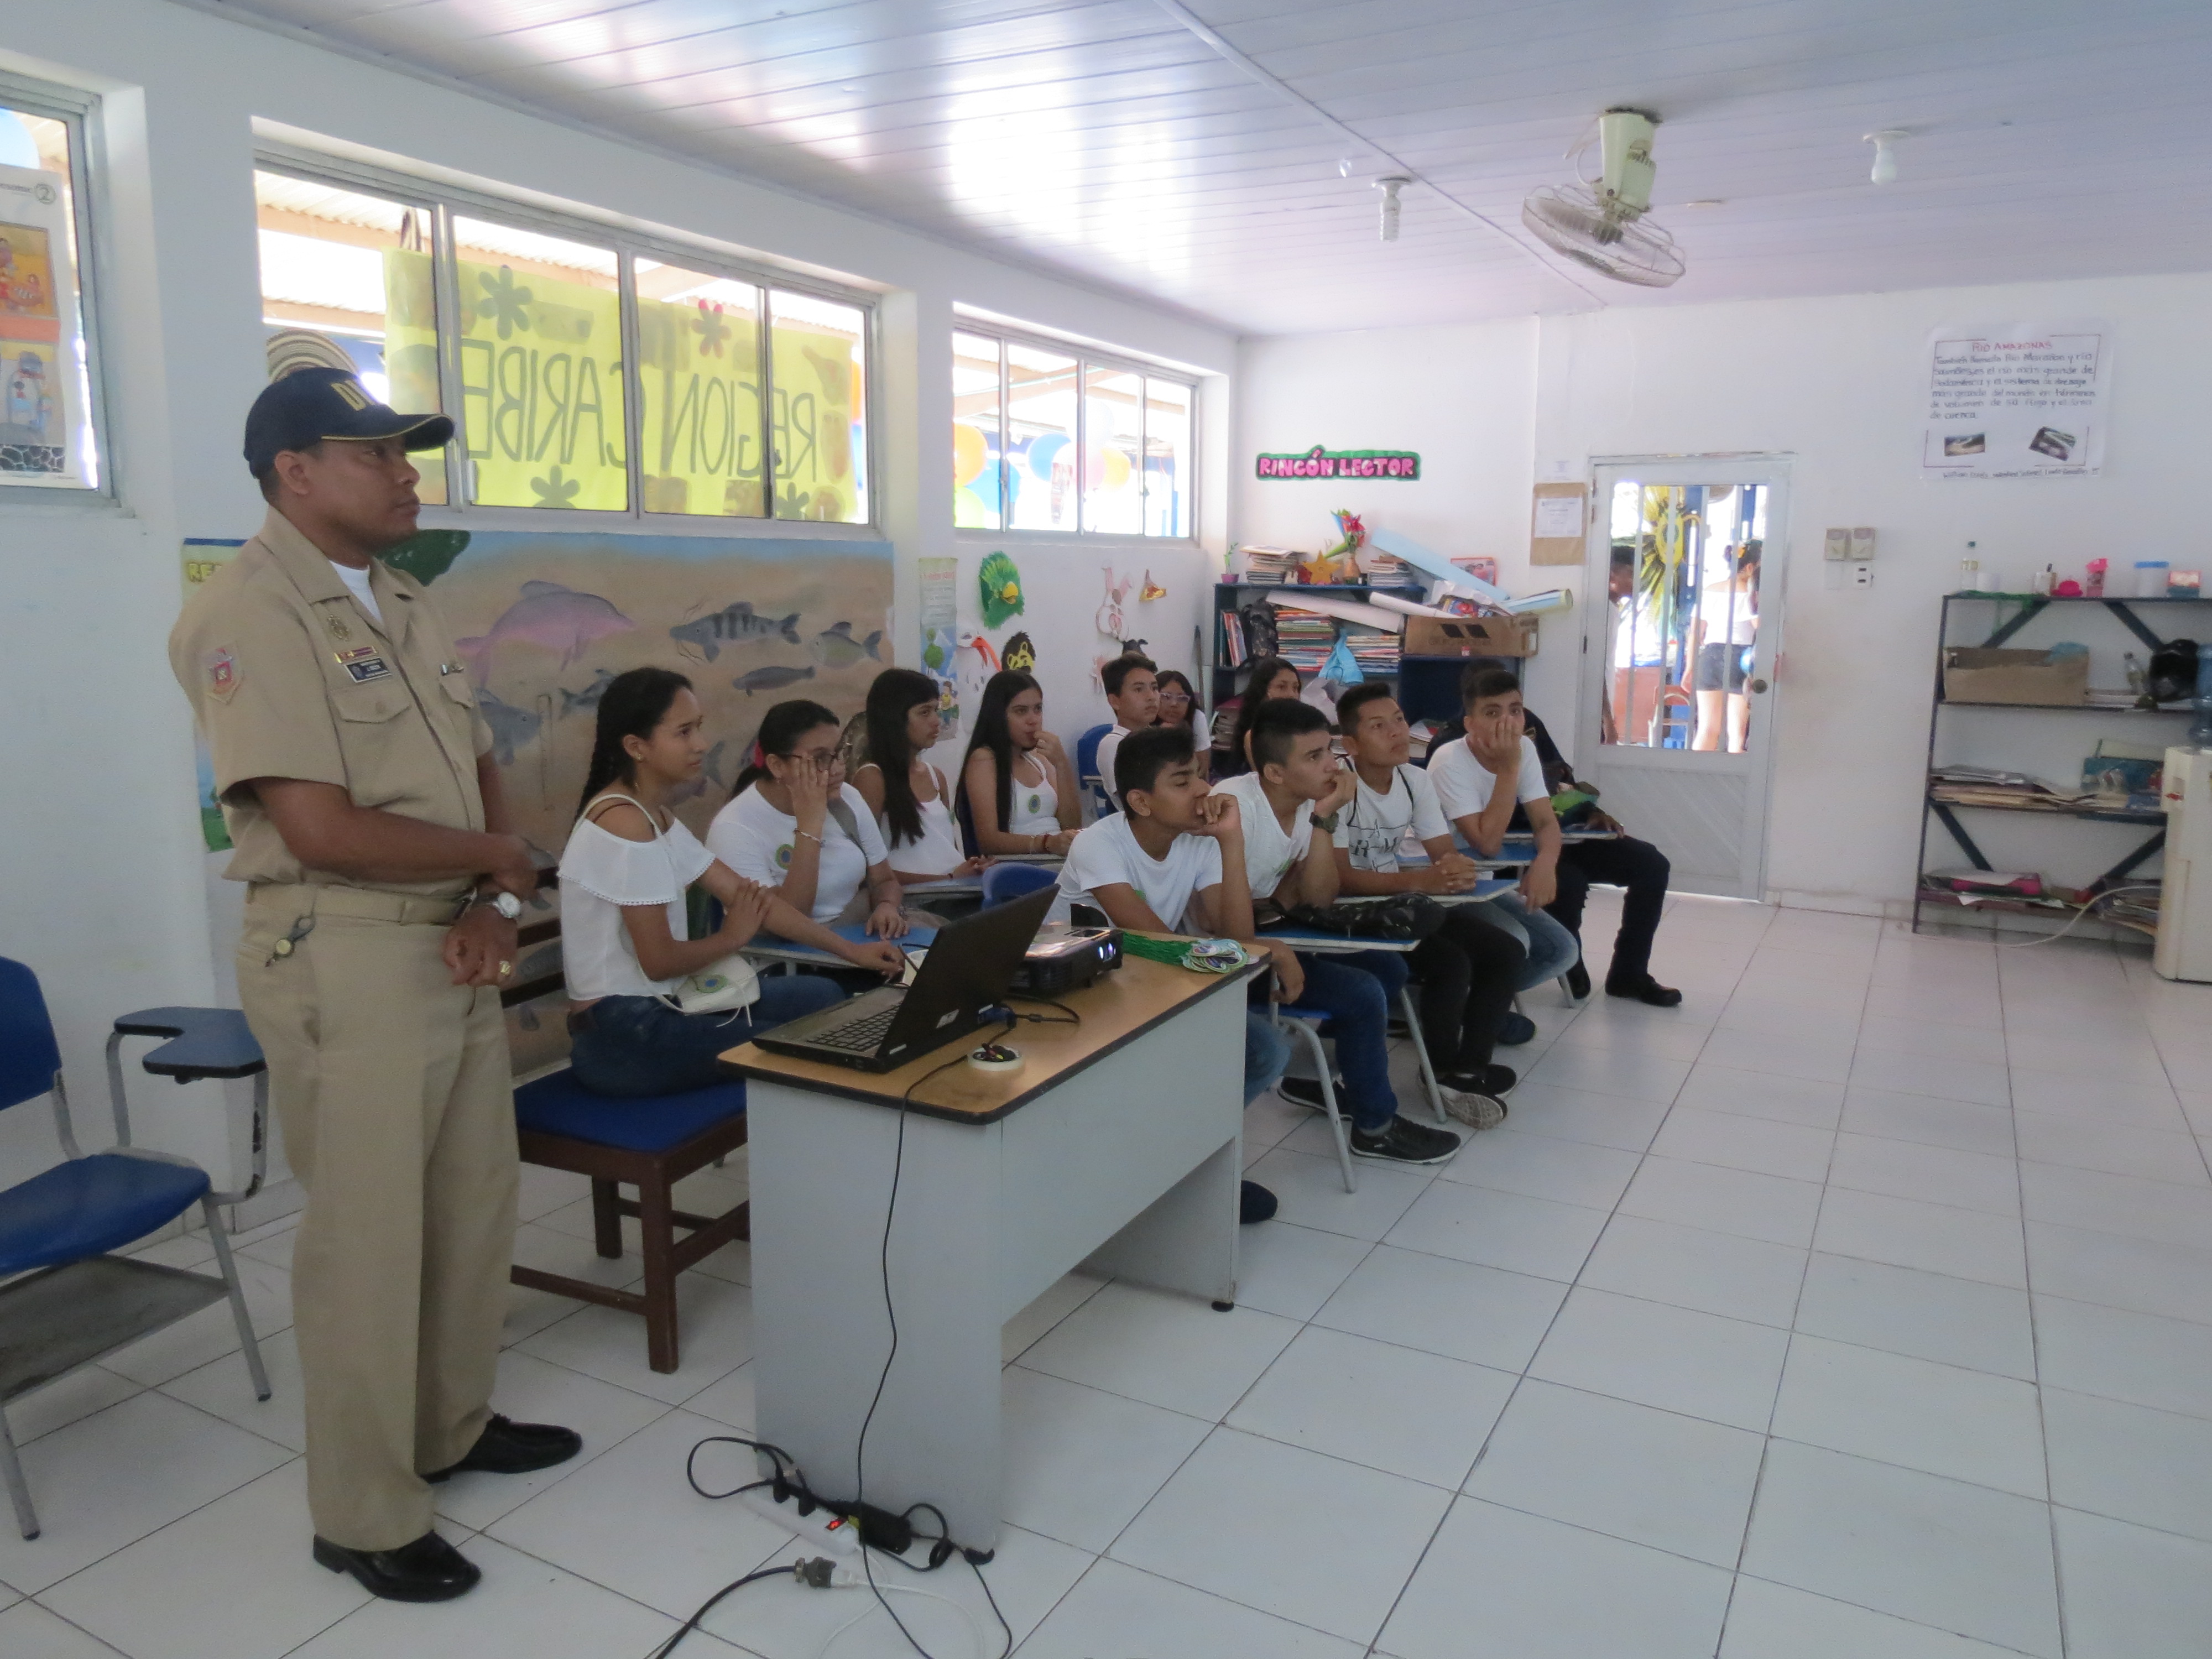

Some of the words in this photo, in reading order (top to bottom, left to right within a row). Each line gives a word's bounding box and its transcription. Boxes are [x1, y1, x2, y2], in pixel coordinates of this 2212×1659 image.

[1995, 341, 2052, 351] AMAZONAS
[1259, 448, 1333, 476] RINCÓN
[1339, 458, 1415, 476] LECTOR
